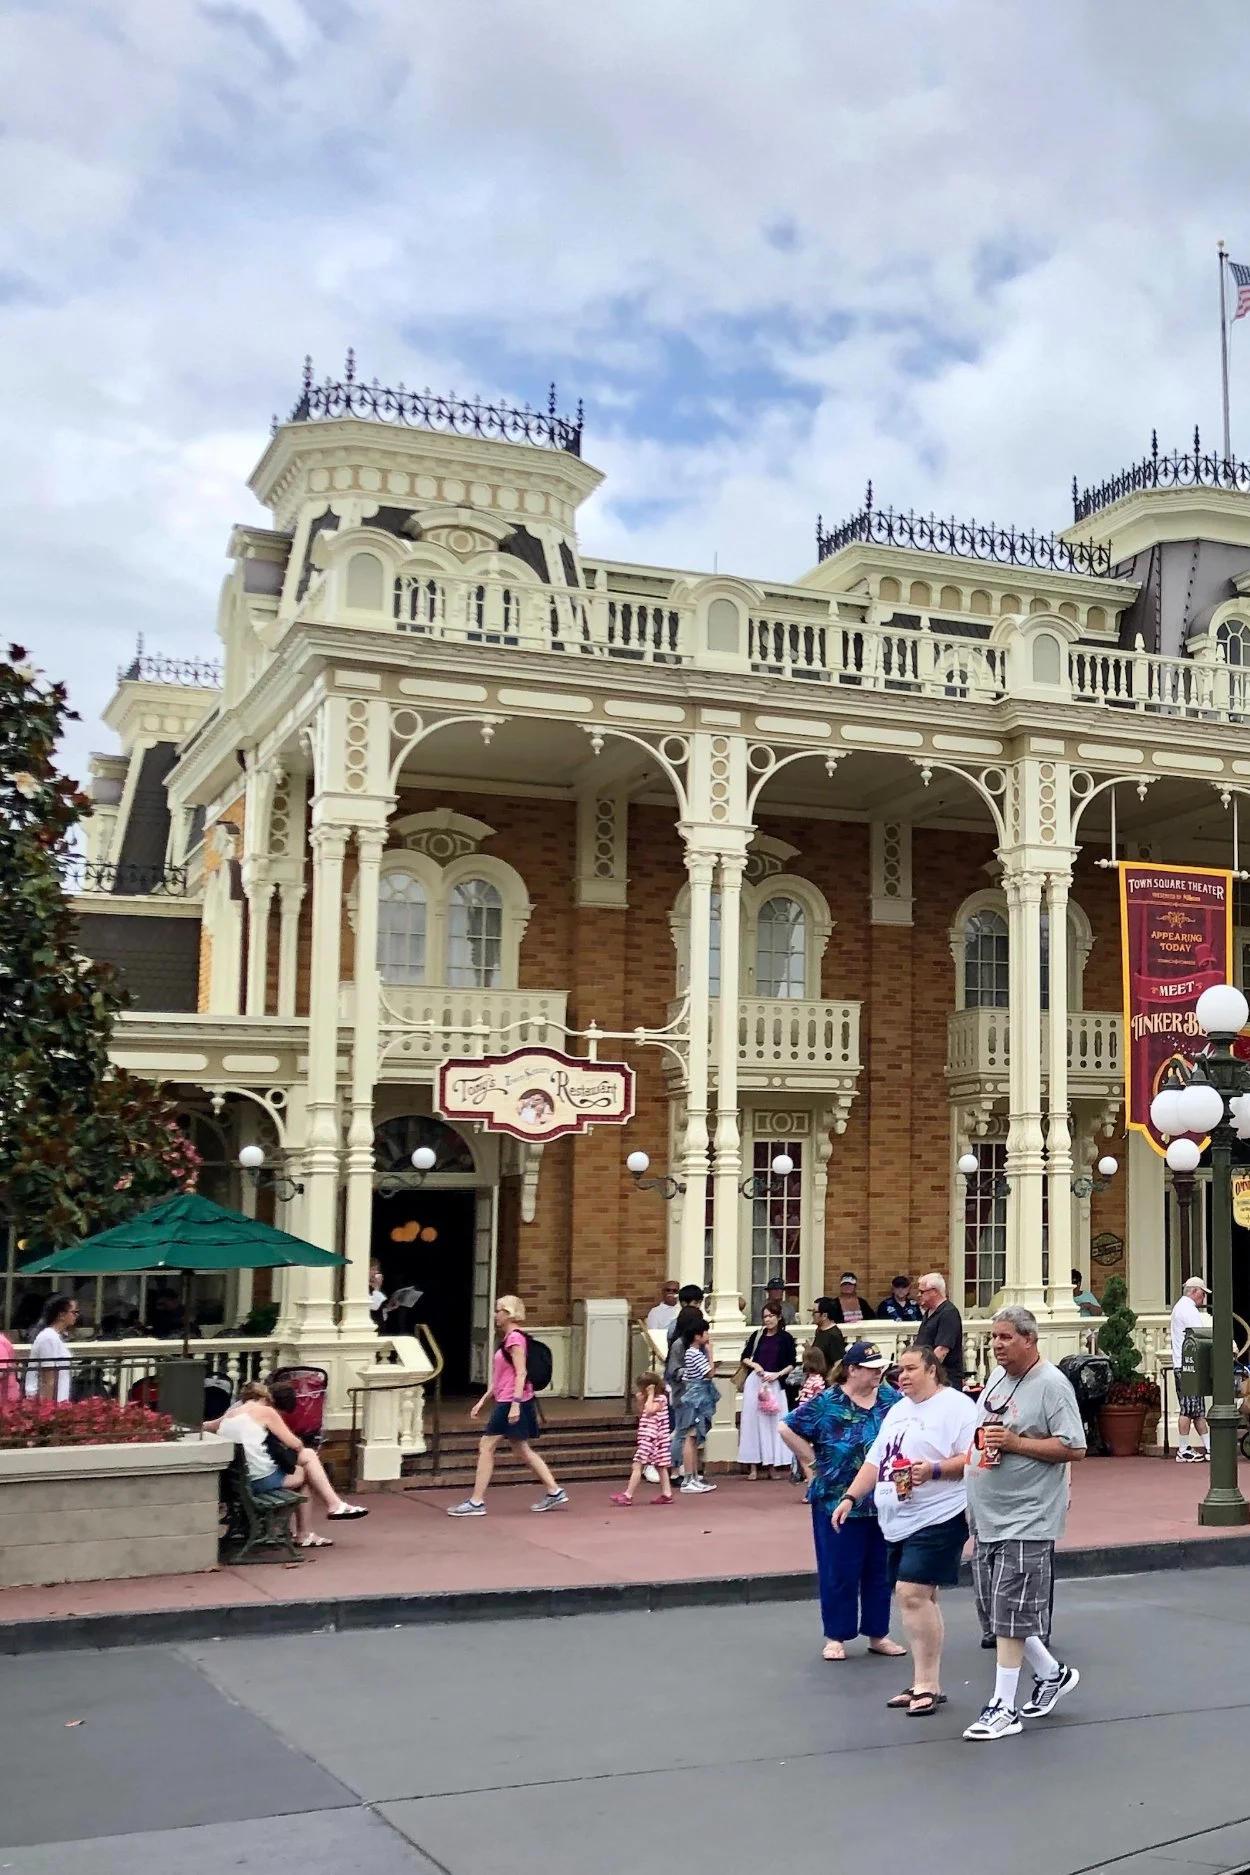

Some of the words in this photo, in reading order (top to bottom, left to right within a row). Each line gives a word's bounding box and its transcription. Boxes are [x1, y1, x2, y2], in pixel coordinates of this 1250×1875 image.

[1128, 879, 1153, 893] TOWN
[1153, 879, 1186, 890] SQUARE
[1187, 881, 1224, 900] THEATER
[1151, 931, 1203, 943] APPEARING
[1160, 943, 1191, 953] TODAY
[1159, 981, 1195, 997] MEET
[1131, 1012, 1184, 1042] TINKER
[453, 1073, 508, 1105] Tony's
[550, 1070, 618, 1109] Restaurant
